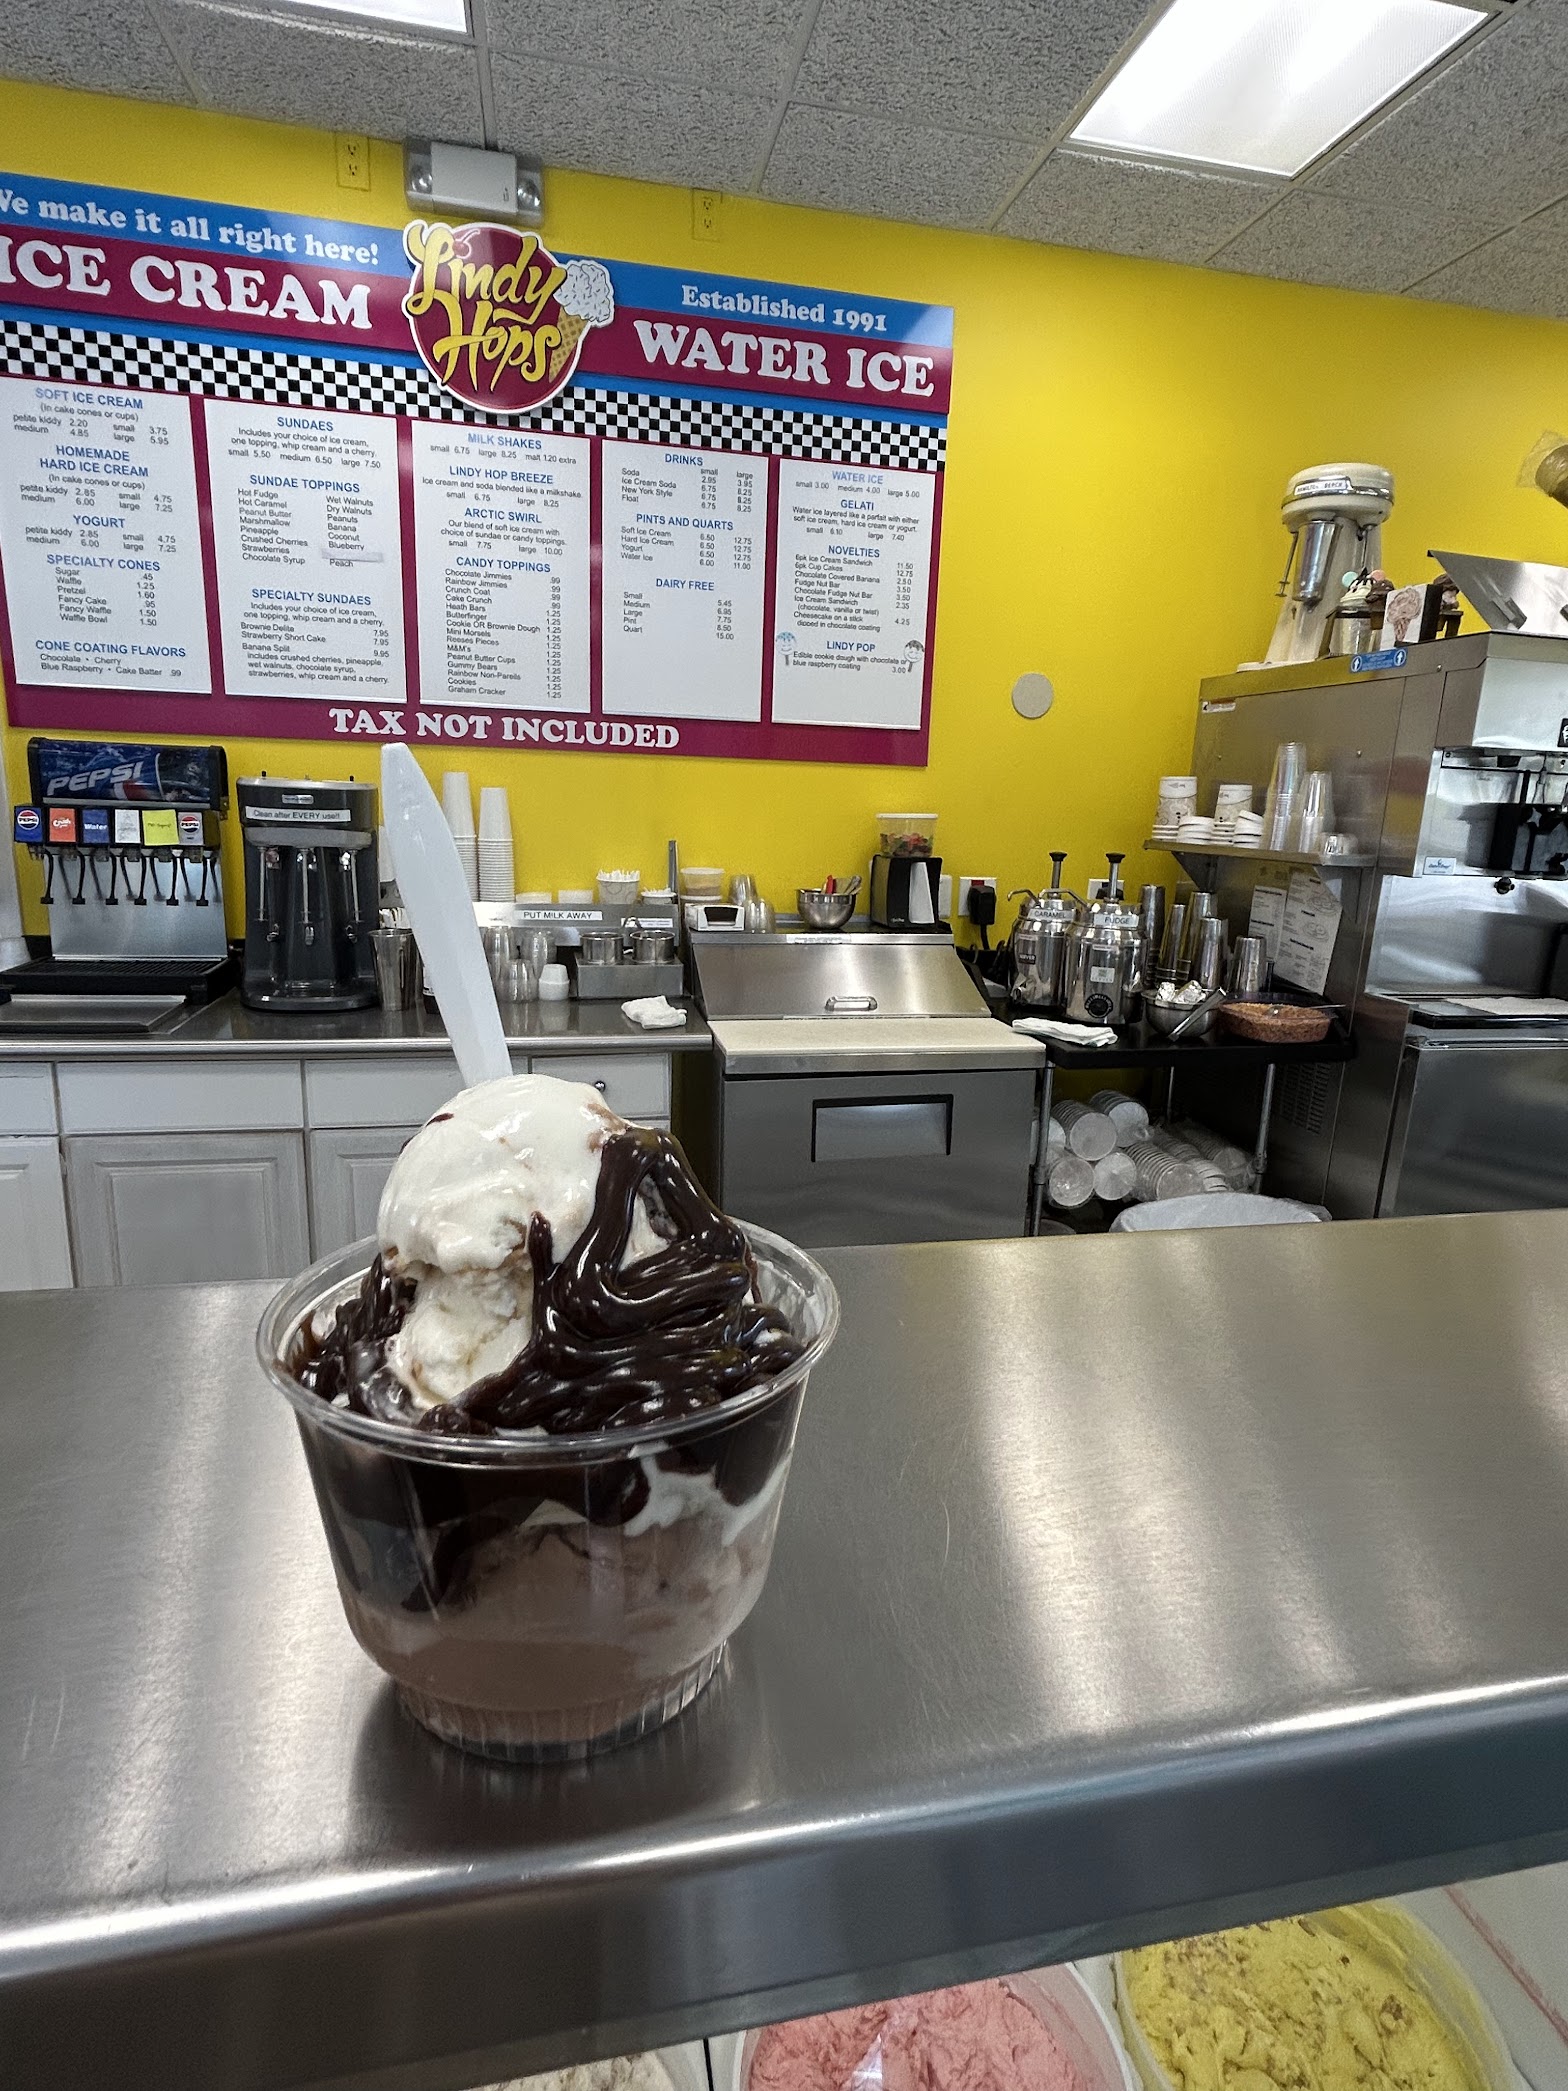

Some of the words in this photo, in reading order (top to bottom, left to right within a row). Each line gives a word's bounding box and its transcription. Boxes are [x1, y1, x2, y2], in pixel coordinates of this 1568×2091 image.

[39, 198, 127, 228] make
[135, 211, 161, 234] it
[171, 217, 208, 241] all
[218, 223, 296, 255] right
[305, 234, 379, 264] here!
[405, 222, 567, 325] Lindy
[0, 237, 111, 297] ICE
[130, 256, 372, 329] CREAM
[682, 285, 825, 325] Established
[832, 308, 887, 331] 1991
[434, 302, 561, 391] Hops
[633, 319, 831, 383] WATER
[846, 349, 935, 397] ICE
[35, 388, 67, 402] SOFT
[73, 393, 94, 404] ICE
[98, 395, 143, 409] CREAM
[277, 417, 333, 431] SUNDAES
[468, 433, 495, 445] MILK
[498, 437, 542, 449] SHAKES
[56, 445, 130, 461] HOMEMADE
[665, 454, 703, 466] DRINKS
[40, 458, 76, 471] HARD
[80, 462, 100, 472] ICE
[104, 465, 148, 476] CREAM
[450, 466, 482, 477] LINDY
[485, 470, 508, 480] HOP
[511, 472, 553, 484] BREEZE
[250, 475, 298, 488] SUNDAE
[302, 479, 360, 492] TOPPINGS
[832, 471, 865, 482] WATER
[868, 475, 883, 484] ICE
[238, 488, 251, 496] Hot
[254, 489, 278, 499] Fudge
[841, 499, 874, 511] GELATI
[73, 515, 125, 528] YOGURT
[240, 517, 290, 526] Marshmallow
[465, 508, 504, 520] ARCTIC
[508, 512, 542, 523] SWIRL
[636, 514, 665, 525] PINTS
[668, 516, 690, 526] AND
[693, 519, 733, 530] QUARTS
[240, 526, 278, 535] Pineapple
[829, 545, 880, 558] NOVELTIES
[47, 555, 114, 568] SPECIALTY
[118, 560, 160, 571] CONES
[457, 557, 494, 568] CANDY
[497, 560, 550, 572] TOPPINGS
[656, 578, 686, 590] DAIRY
[689, 581, 714, 591] FREE
[252, 589, 314, 601] SPECIALTY
[318, 593, 371, 605] SUNDAES
[36, 640, 70, 650] CONE
[74, 643, 127, 654] COATING
[132, 646, 186, 657] FLAVORS
[827, 641, 854, 651] LINDY
[857, 644, 875, 652] POP
[329, 708, 406, 735] TAX
[416, 712, 492, 739] NOT
[501, 716, 680, 749] INCLUDED
[47, 761, 144, 795] PEPSI
[1035, 910, 1066, 918] CARAMEL
